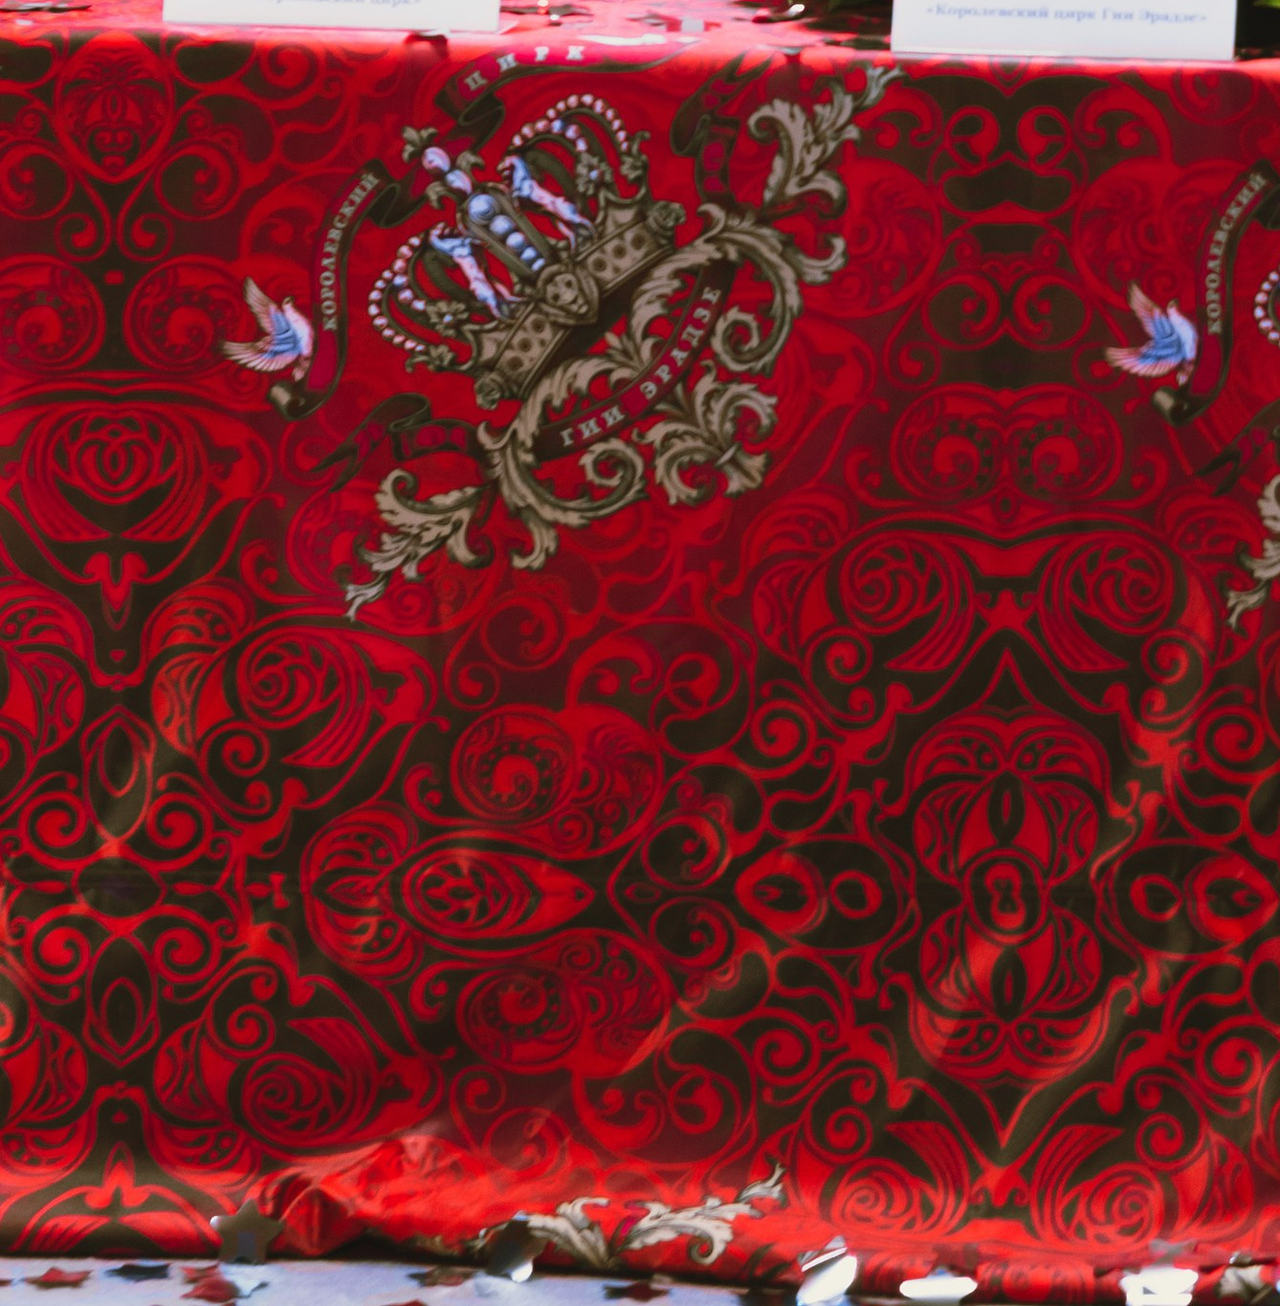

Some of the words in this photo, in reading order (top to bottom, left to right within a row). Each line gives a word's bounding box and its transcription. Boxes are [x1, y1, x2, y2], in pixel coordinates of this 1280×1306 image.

[1054, 9, 1095, 23] цирк
[1102, 8, 1135, 21] Гии
[640, 286, 721, 399] ЭРАДЗЕ
